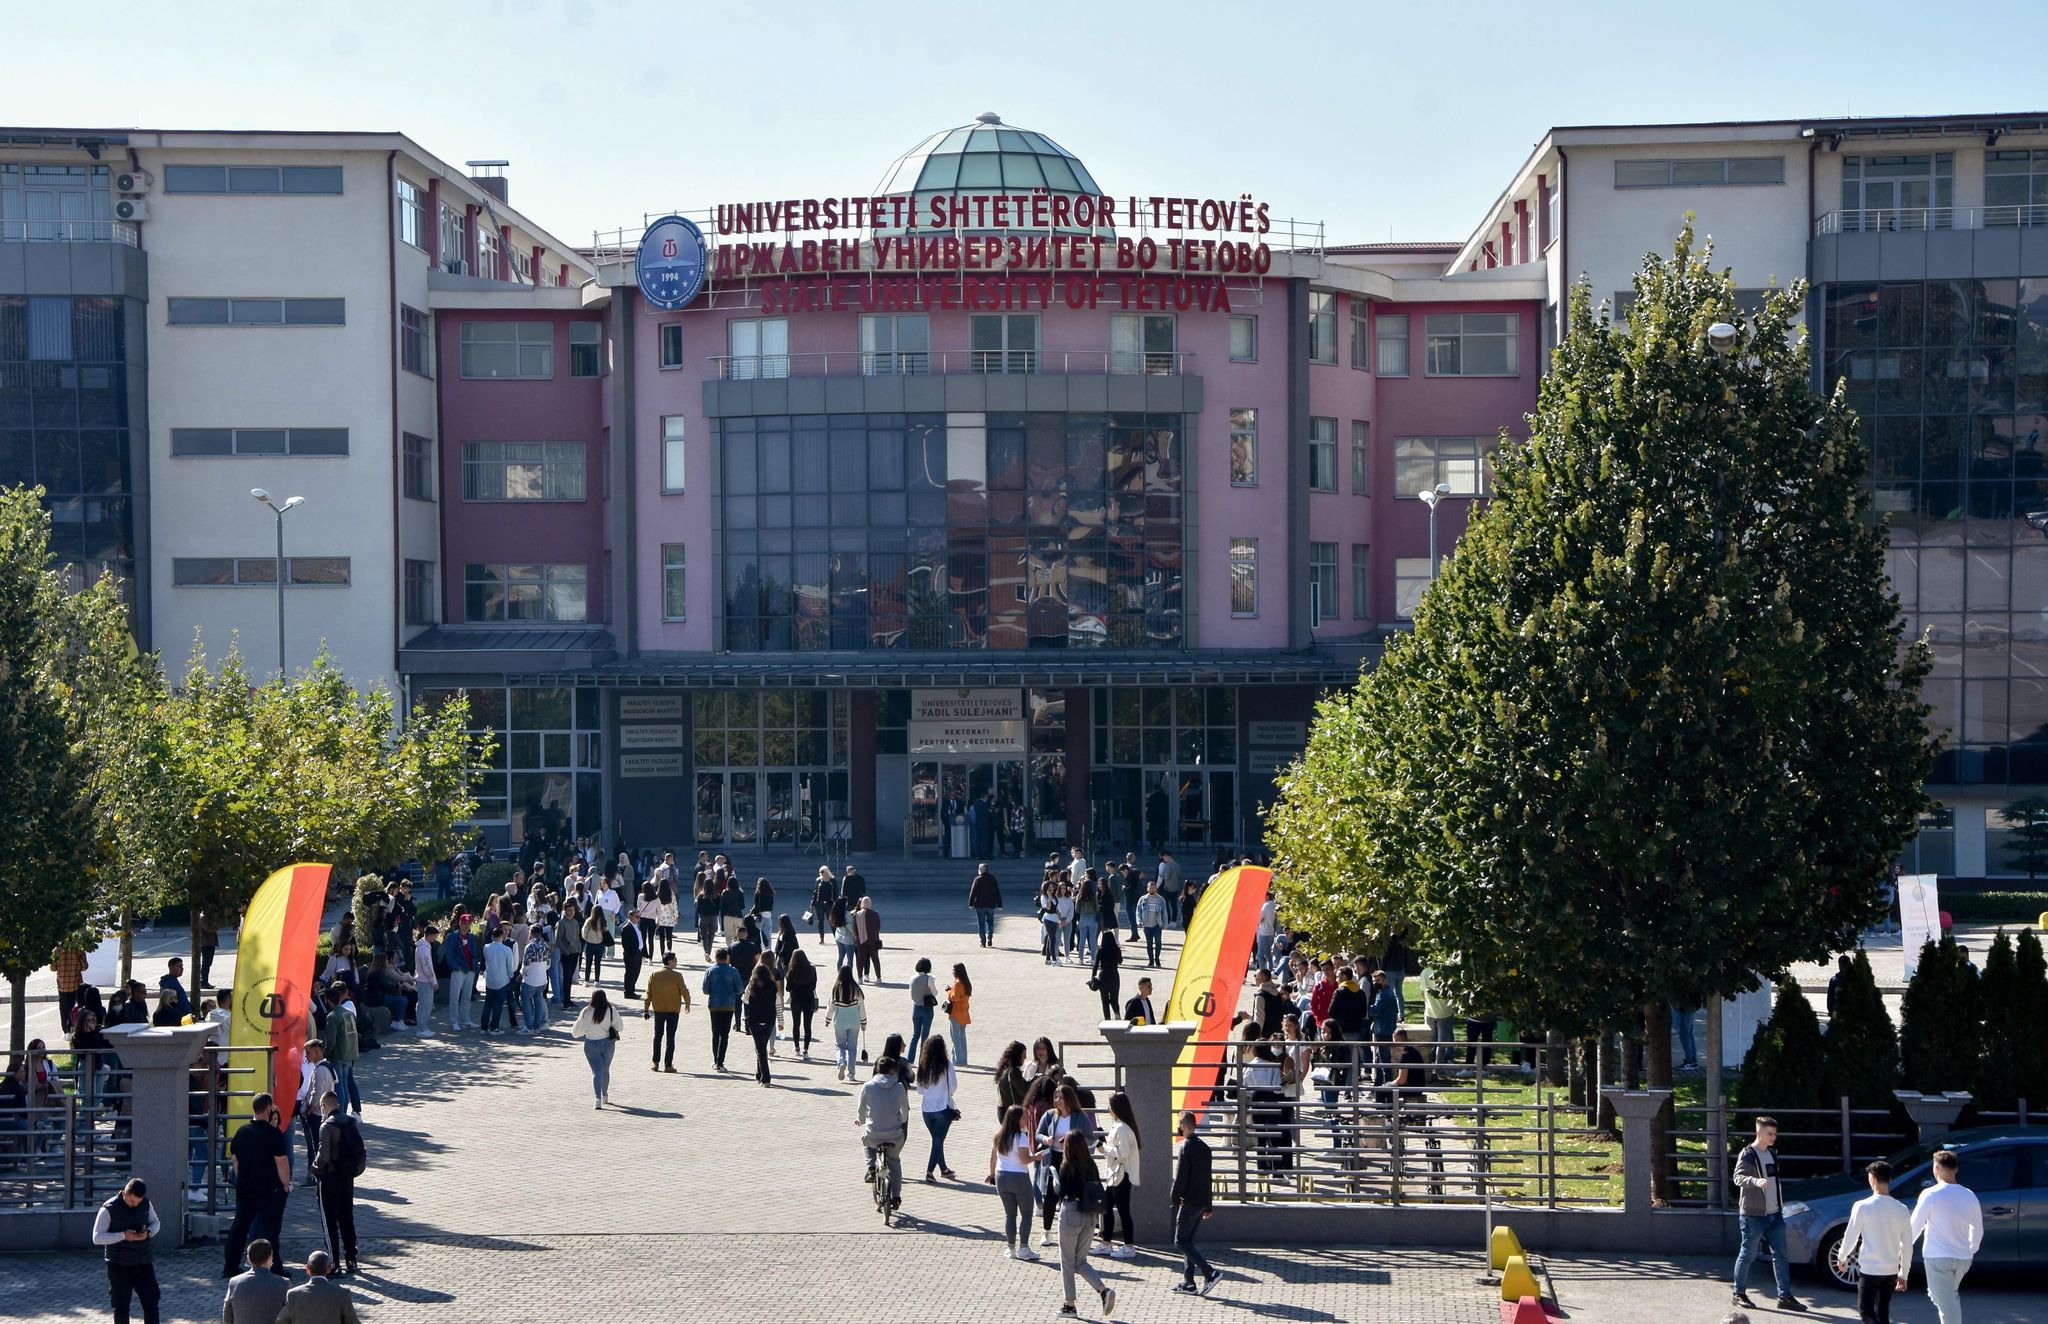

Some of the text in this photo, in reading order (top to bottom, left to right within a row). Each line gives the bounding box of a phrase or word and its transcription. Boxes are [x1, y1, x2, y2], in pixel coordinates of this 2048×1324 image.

[717, 195, 916, 236] UNIVERSITETI
[930, 187, 1116, 229] SHTETËROR
[1129, 196, 1136, 228] I
[1149, 193, 1271, 235] TETOVËS
[715, 238, 860, 280] ДРЖАВЕН
[873, 235, 1106, 271] УНИВЕРЗИТЕТ
[1117, 236, 1158, 270] ВО
[1167, 237, 1271, 275] ТЕТОВО
[661, 272, 679, 282] 1994
[761, 275, 1232, 315] STATE UNIVERSITY OF TETOVA
[921, 699, 974, 707] UNIVERSITETI
[979, 698, 1012, 706] TETOVËS
[916, 706, 1018, 717] "FADIL SULEJMANI"
[944, 728, 990, 736] REKTORATI
